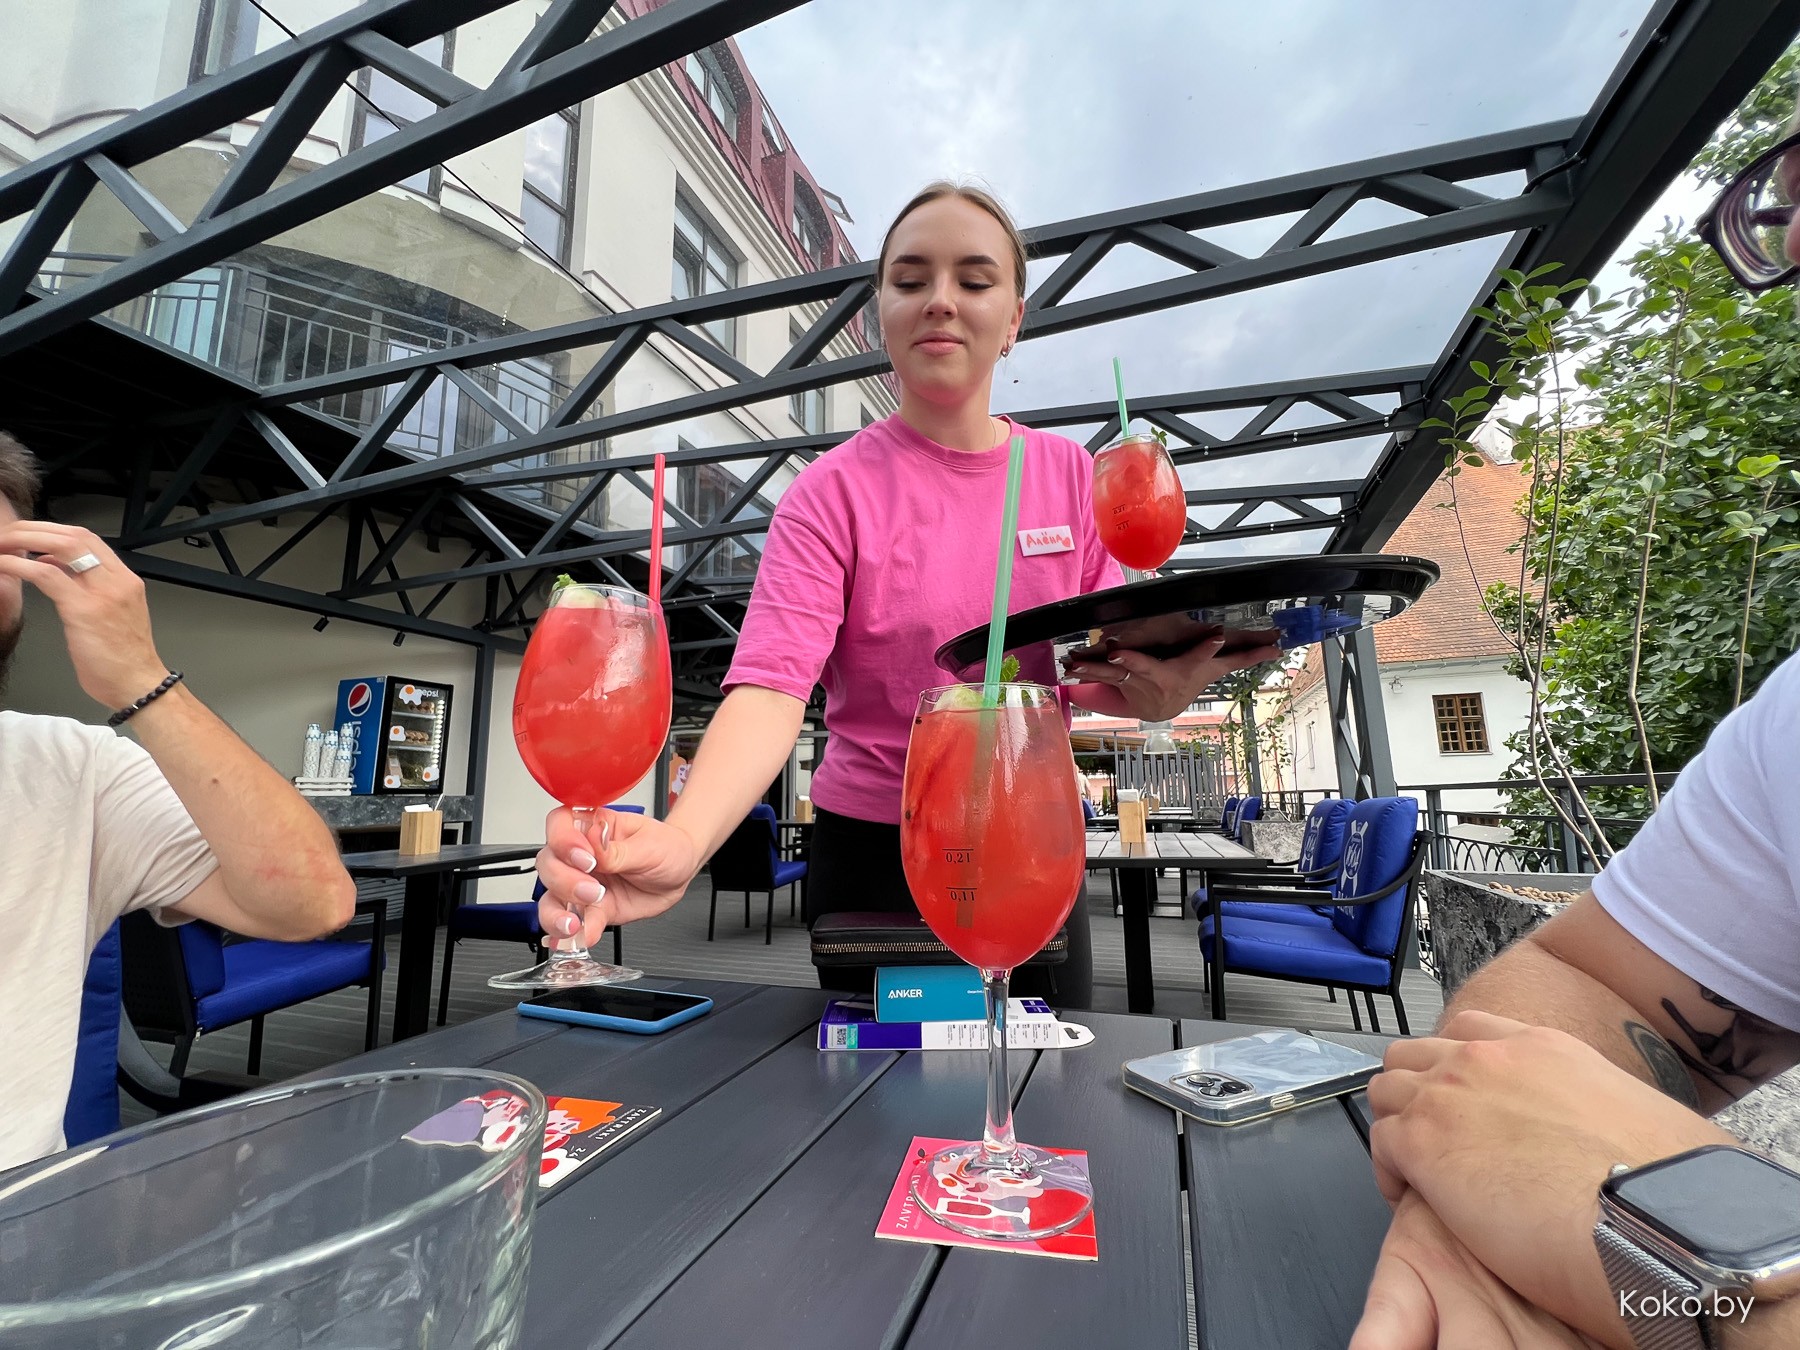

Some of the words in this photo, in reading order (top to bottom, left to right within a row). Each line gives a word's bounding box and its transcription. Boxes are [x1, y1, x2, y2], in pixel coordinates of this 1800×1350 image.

[887, 988, 923, 1000] ANKER
[595, 1108, 647, 1140] ZAVTRAKI
[895, 1173, 922, 1229] ZAVTRKI
